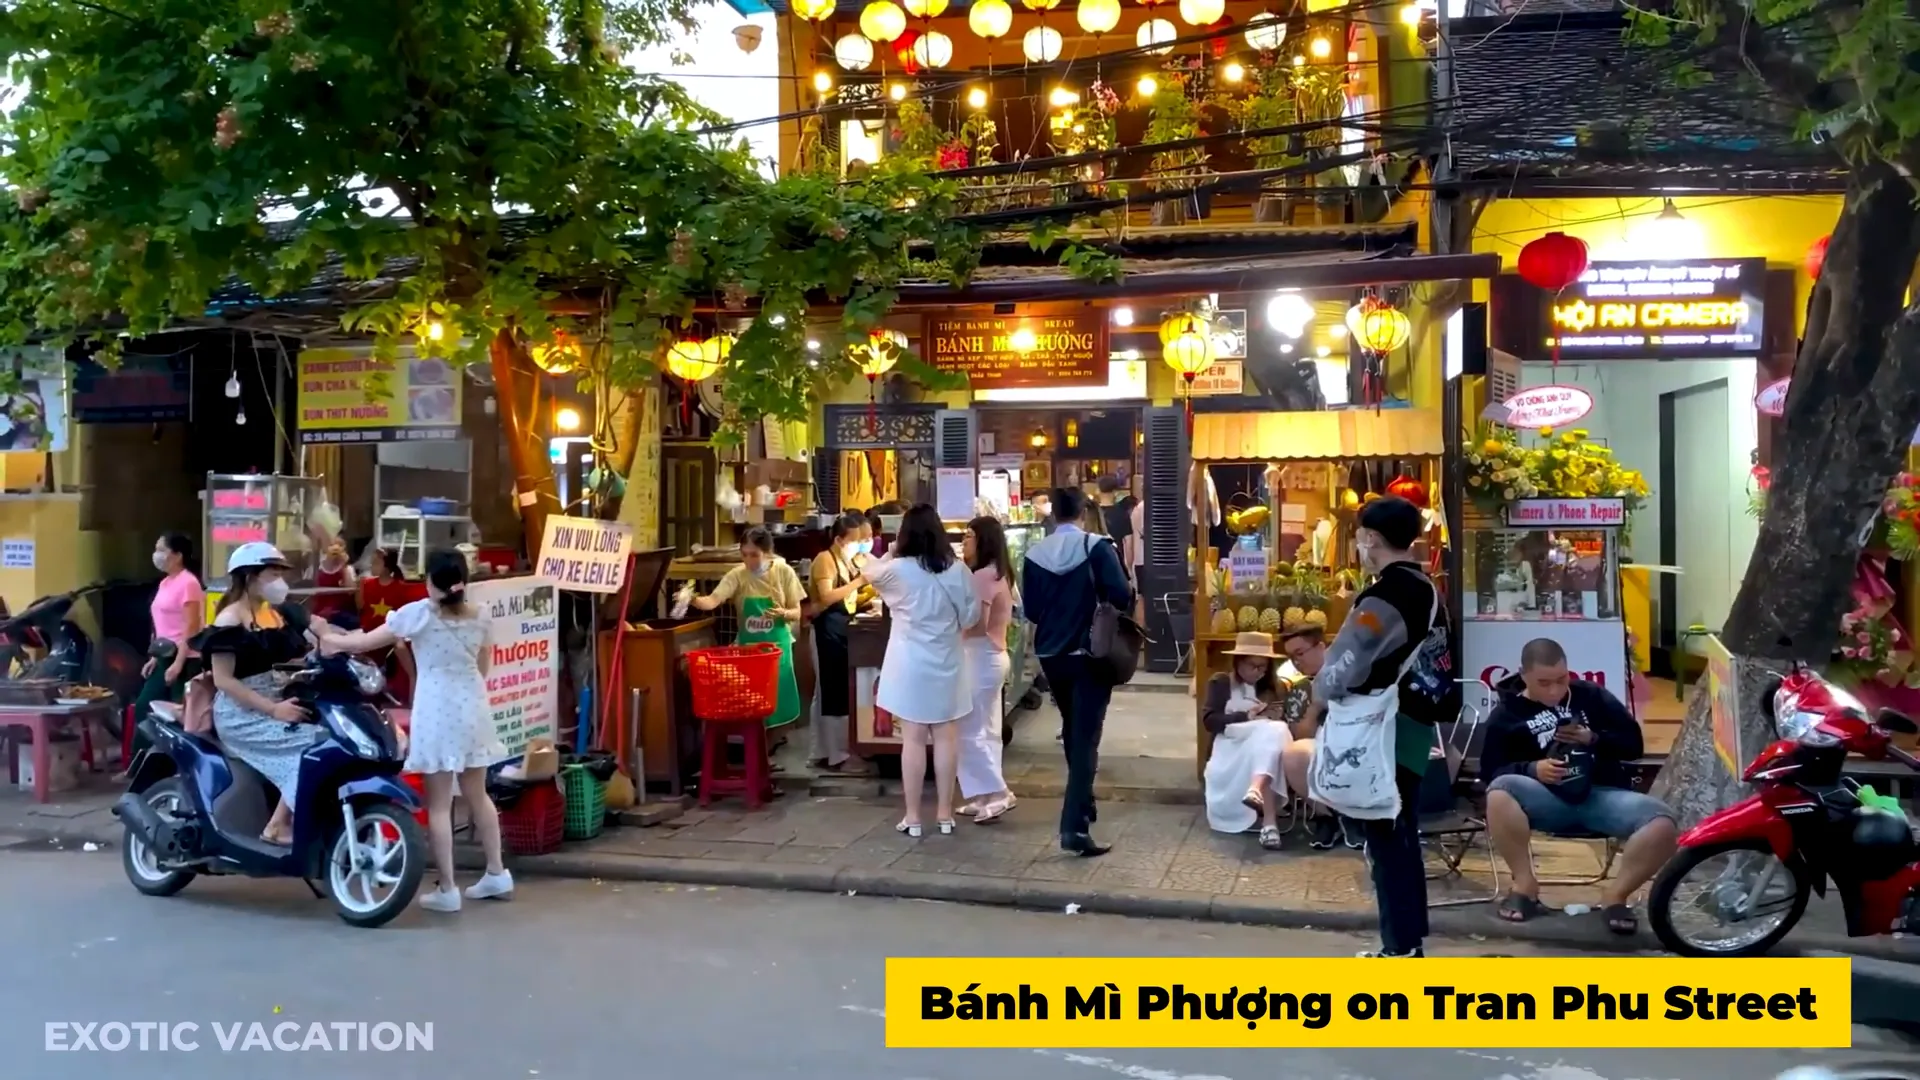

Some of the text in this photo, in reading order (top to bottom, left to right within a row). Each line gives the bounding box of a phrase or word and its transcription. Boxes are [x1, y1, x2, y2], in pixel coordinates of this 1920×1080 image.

[1045, 320, 1074, 328] BREAD
[1554, 299, 1749, 332] HỘI AN CAMERA
[936, 332, 984, 353] BÁNH
[1197, 366, 1226, 377] PEN
[1547, 504, 1554, 519] &
[1558, 503, 1586, 519] Phone
[1590, 503, 1621, 522] Repair
[552, 526, 573, 549] XIN
[574, 529, 593, 552] VUI
[566, 560, 582, 583] XE
[521, 618, 556, 635] Bread
[748, 618, 773, 630] MILO
[491, 639, 549, 666] hượng
[1780, 806, 1814, 815] HONDA
